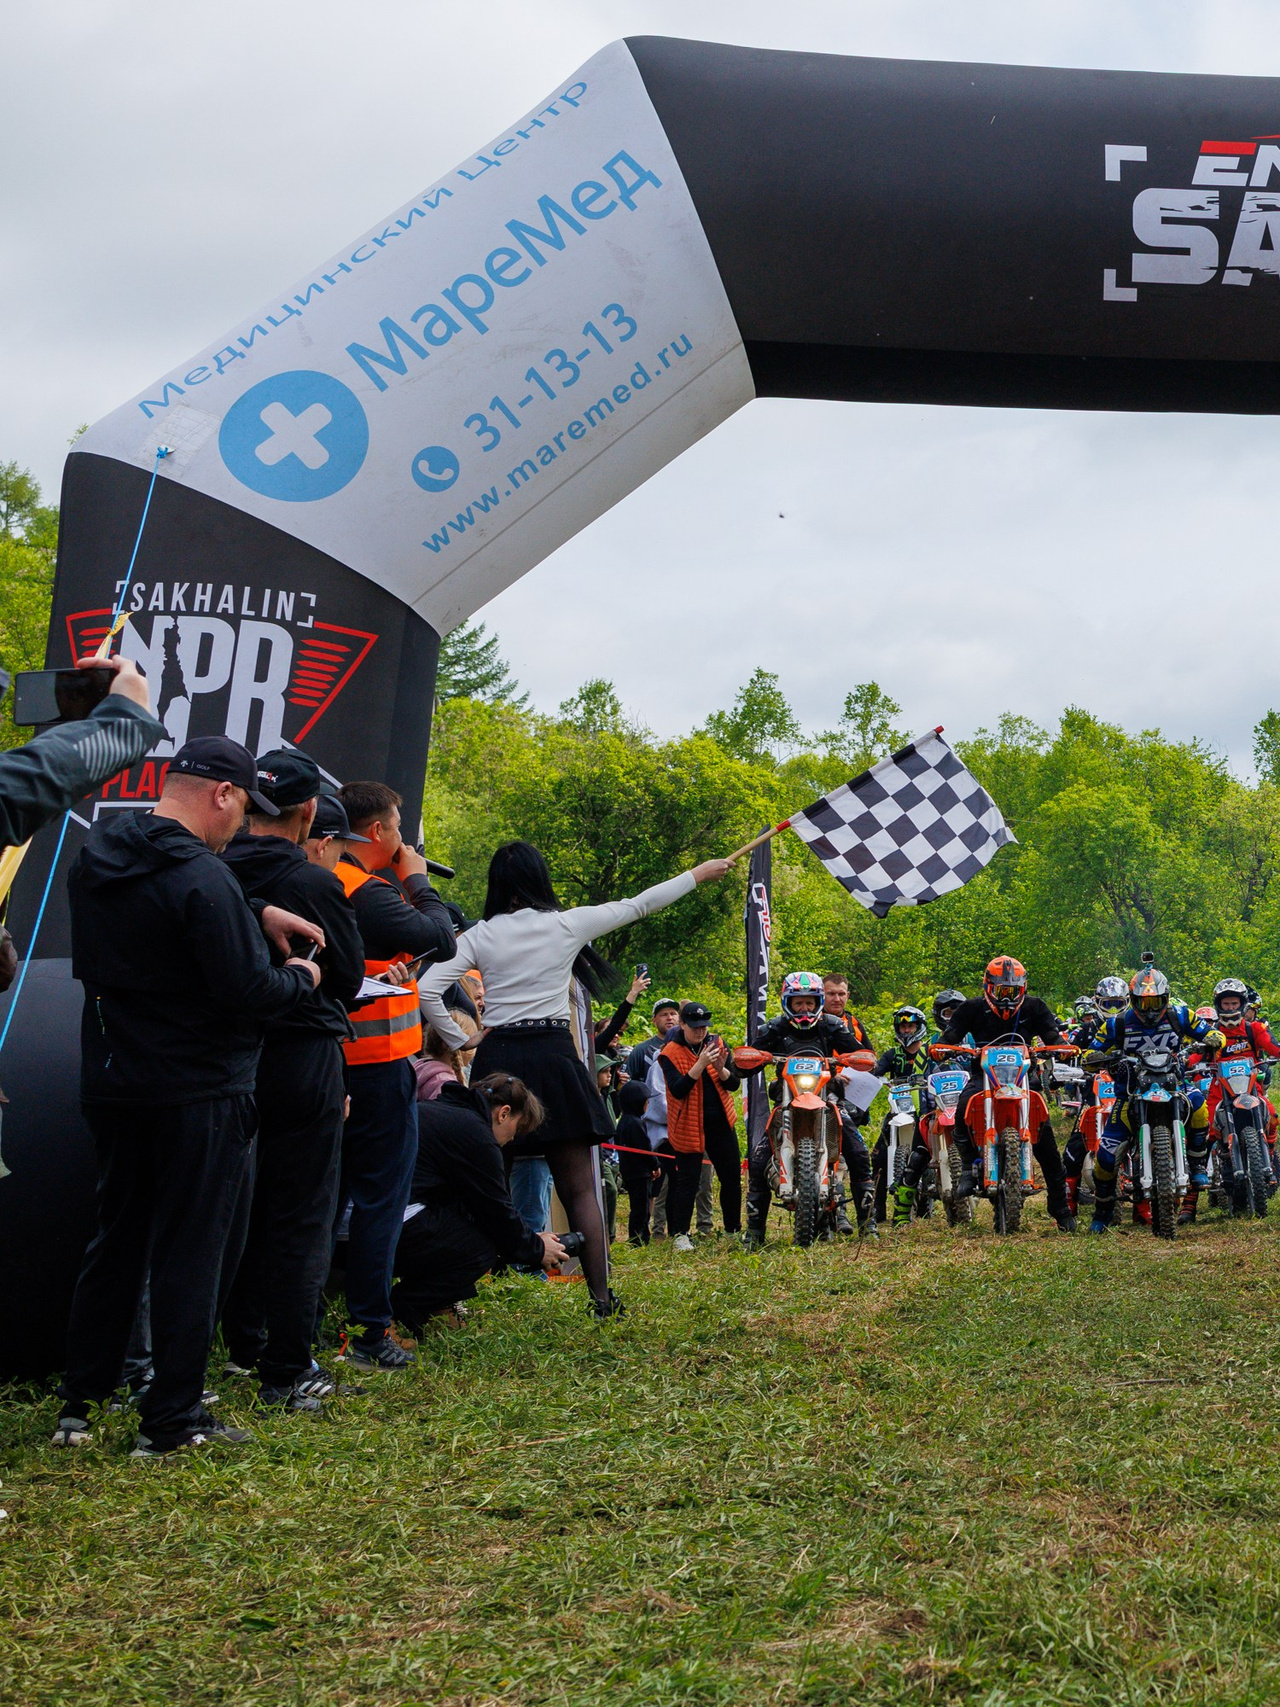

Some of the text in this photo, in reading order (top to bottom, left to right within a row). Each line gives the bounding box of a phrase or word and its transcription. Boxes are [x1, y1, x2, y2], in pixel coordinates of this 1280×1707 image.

[136, 80, 589, 419] Медицинский Центр
[345, 150, 662, 393] МареМед
[463, 302, 640, 452] 31-13-13
[421, 334, 694, 555] www.maremed.ru
[132, 582, 296, 620] SAKHALIN
[119, 614, 295, 759] NPR
[794, 1062, 814, 1071] 62
[997, 1054, 1016, 1063] 26
[1229, 1066, 1245, 1075] 52
[941, 1081, 958, 1091] 25
[1103, 1087, 1115, 1095] 4
